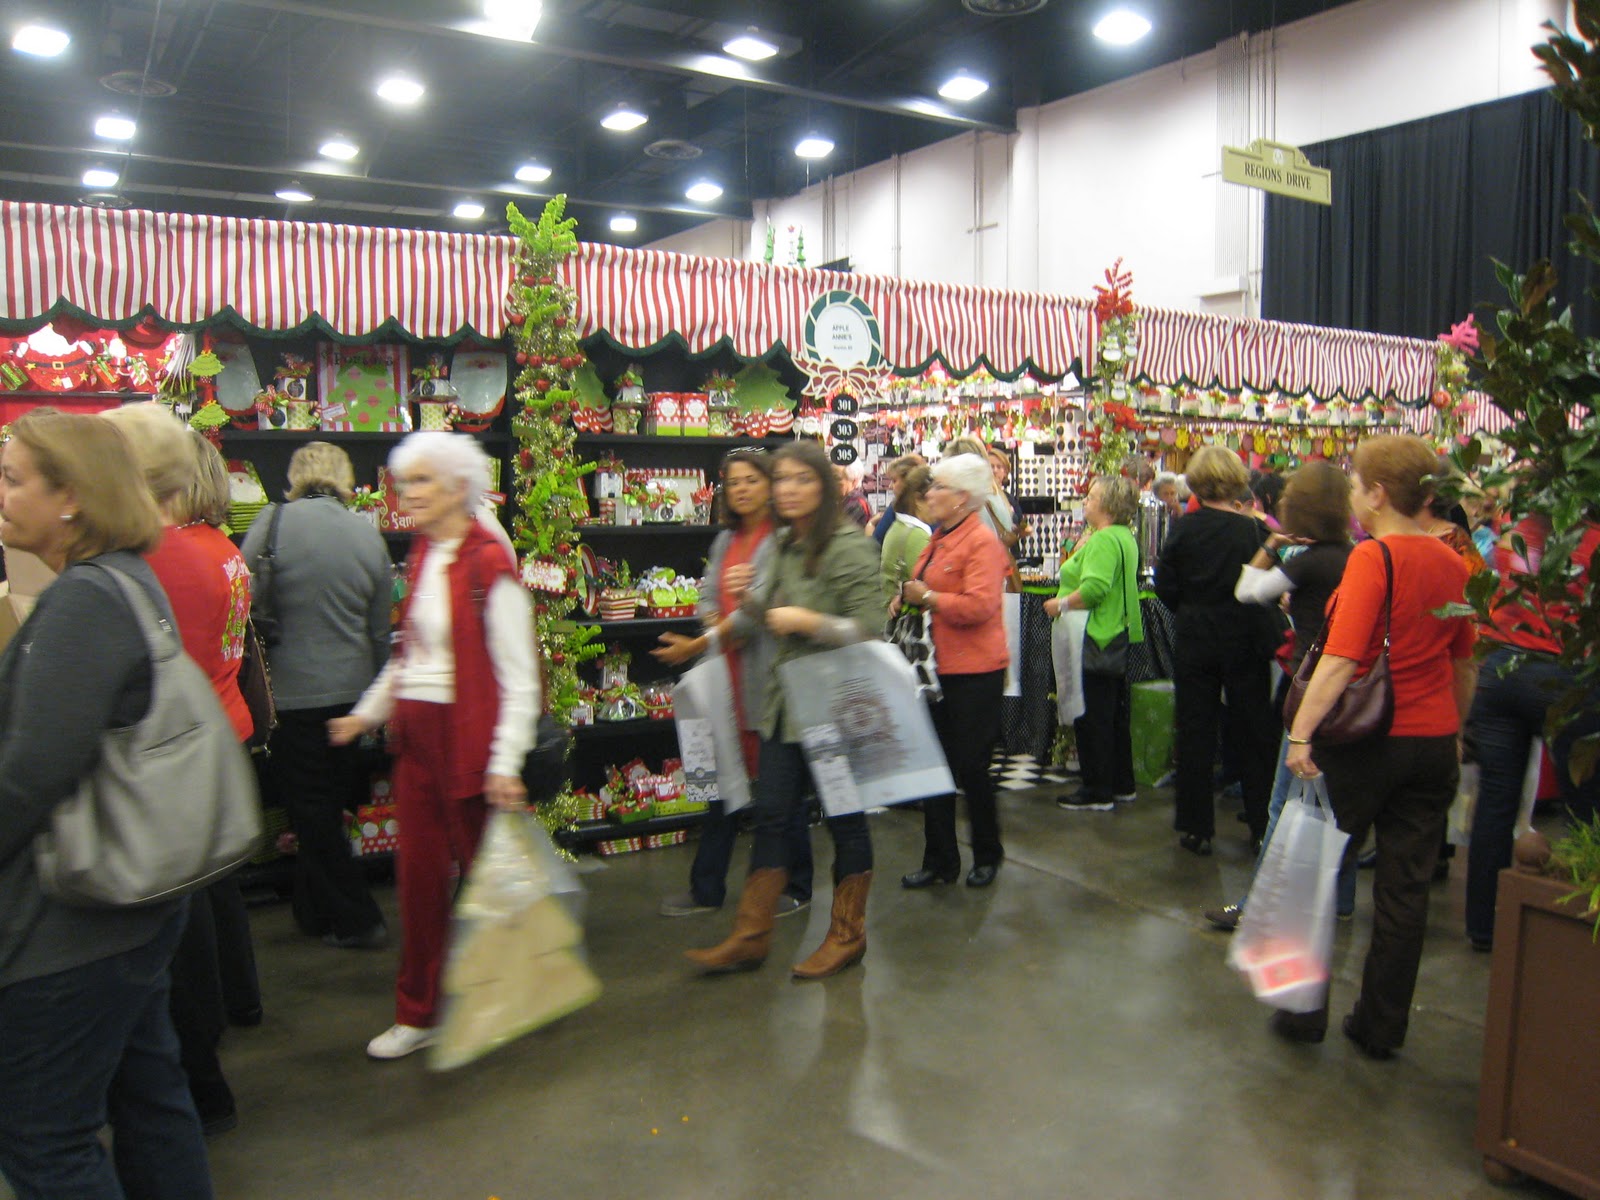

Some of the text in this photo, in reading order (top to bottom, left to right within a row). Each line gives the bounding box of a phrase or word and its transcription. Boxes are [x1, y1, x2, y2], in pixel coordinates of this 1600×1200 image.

[1244, 162, 1312, 191] REGIONS DRIVE
[837, 399, 851, 411] 301
[836, 424, 852, 436] 303
[836, 448, 852, 461] 305
